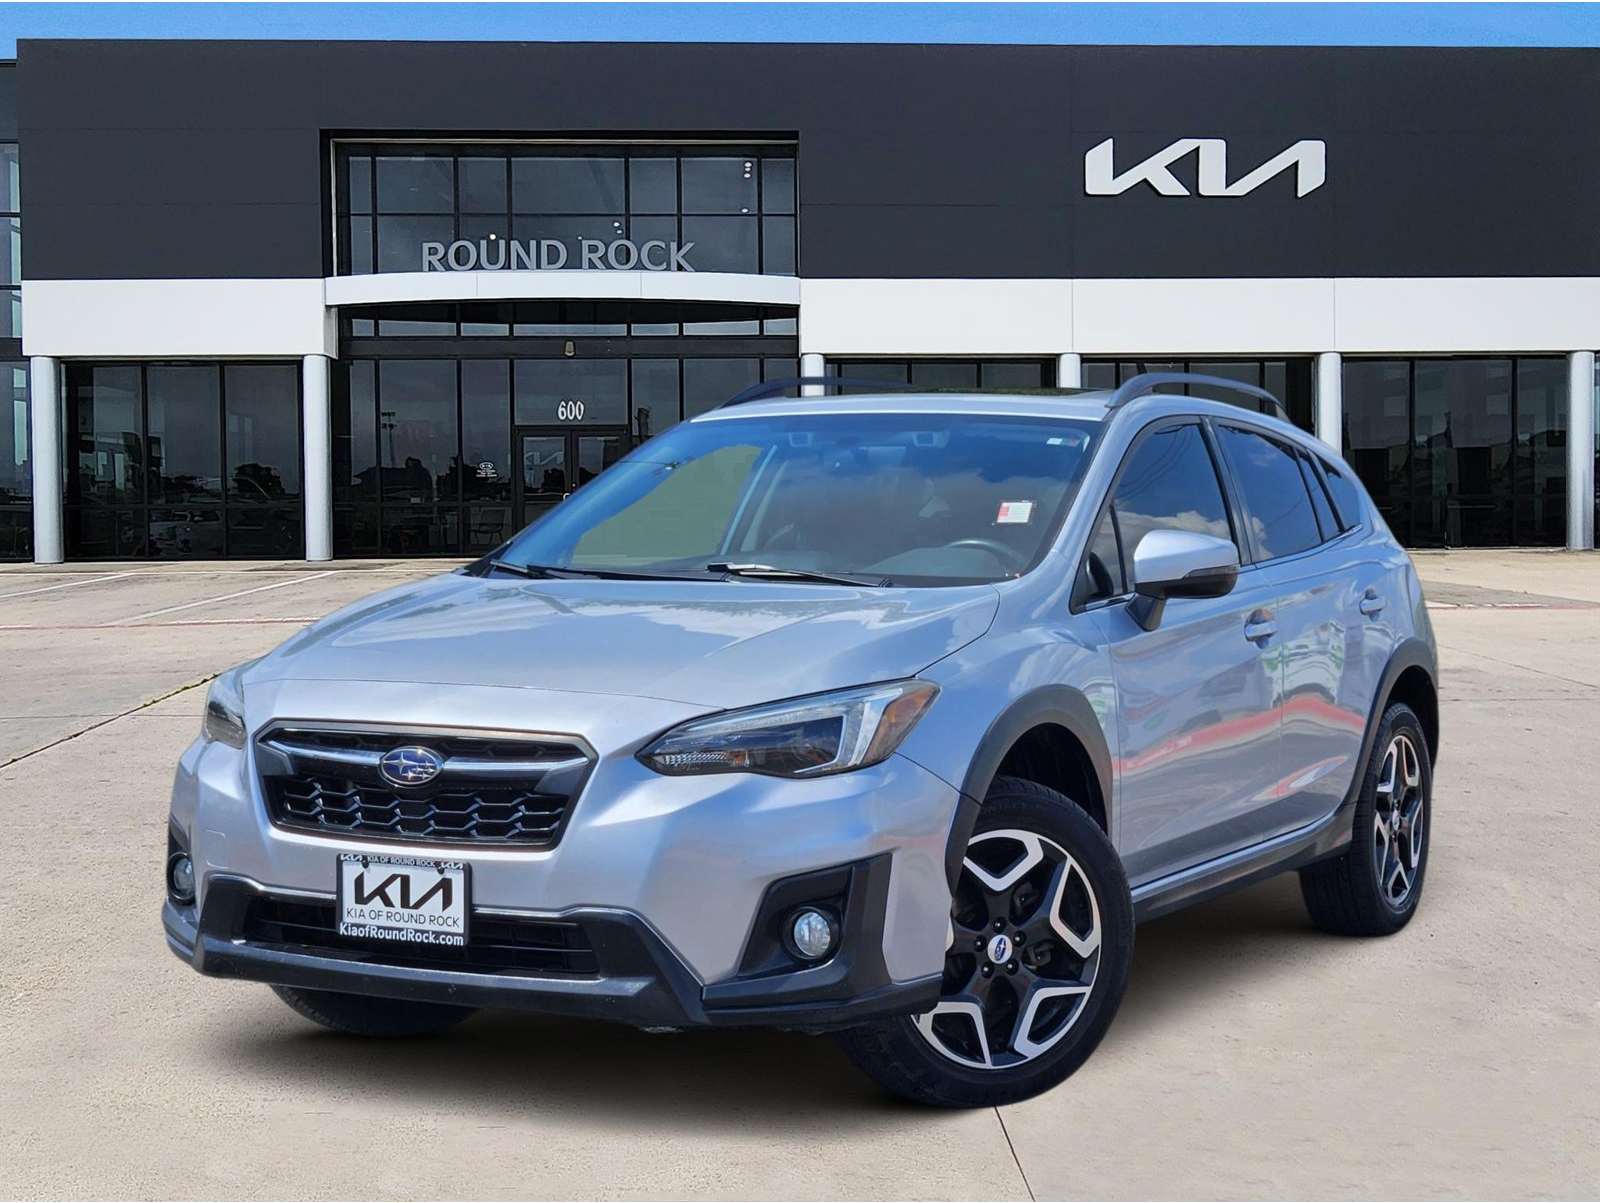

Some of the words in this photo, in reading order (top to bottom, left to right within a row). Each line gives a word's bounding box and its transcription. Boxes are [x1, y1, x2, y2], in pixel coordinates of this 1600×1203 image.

[1085, 138, 1325, 198] KIA
[422, 239, 567, 272] ROUND
[581, 239, 695, 272] ROCK
[558, 400, 584, 420] 600
[354, 871, 453, 912] KIA
[346, 907, 366, 919] KIA
[369, 909, 383, 920] OF
[386, 911, 426, 925] ROUND
[429, 915, 460, 928] ROCK
[340, 922, 464, 946] KiaofRoundRock.com
